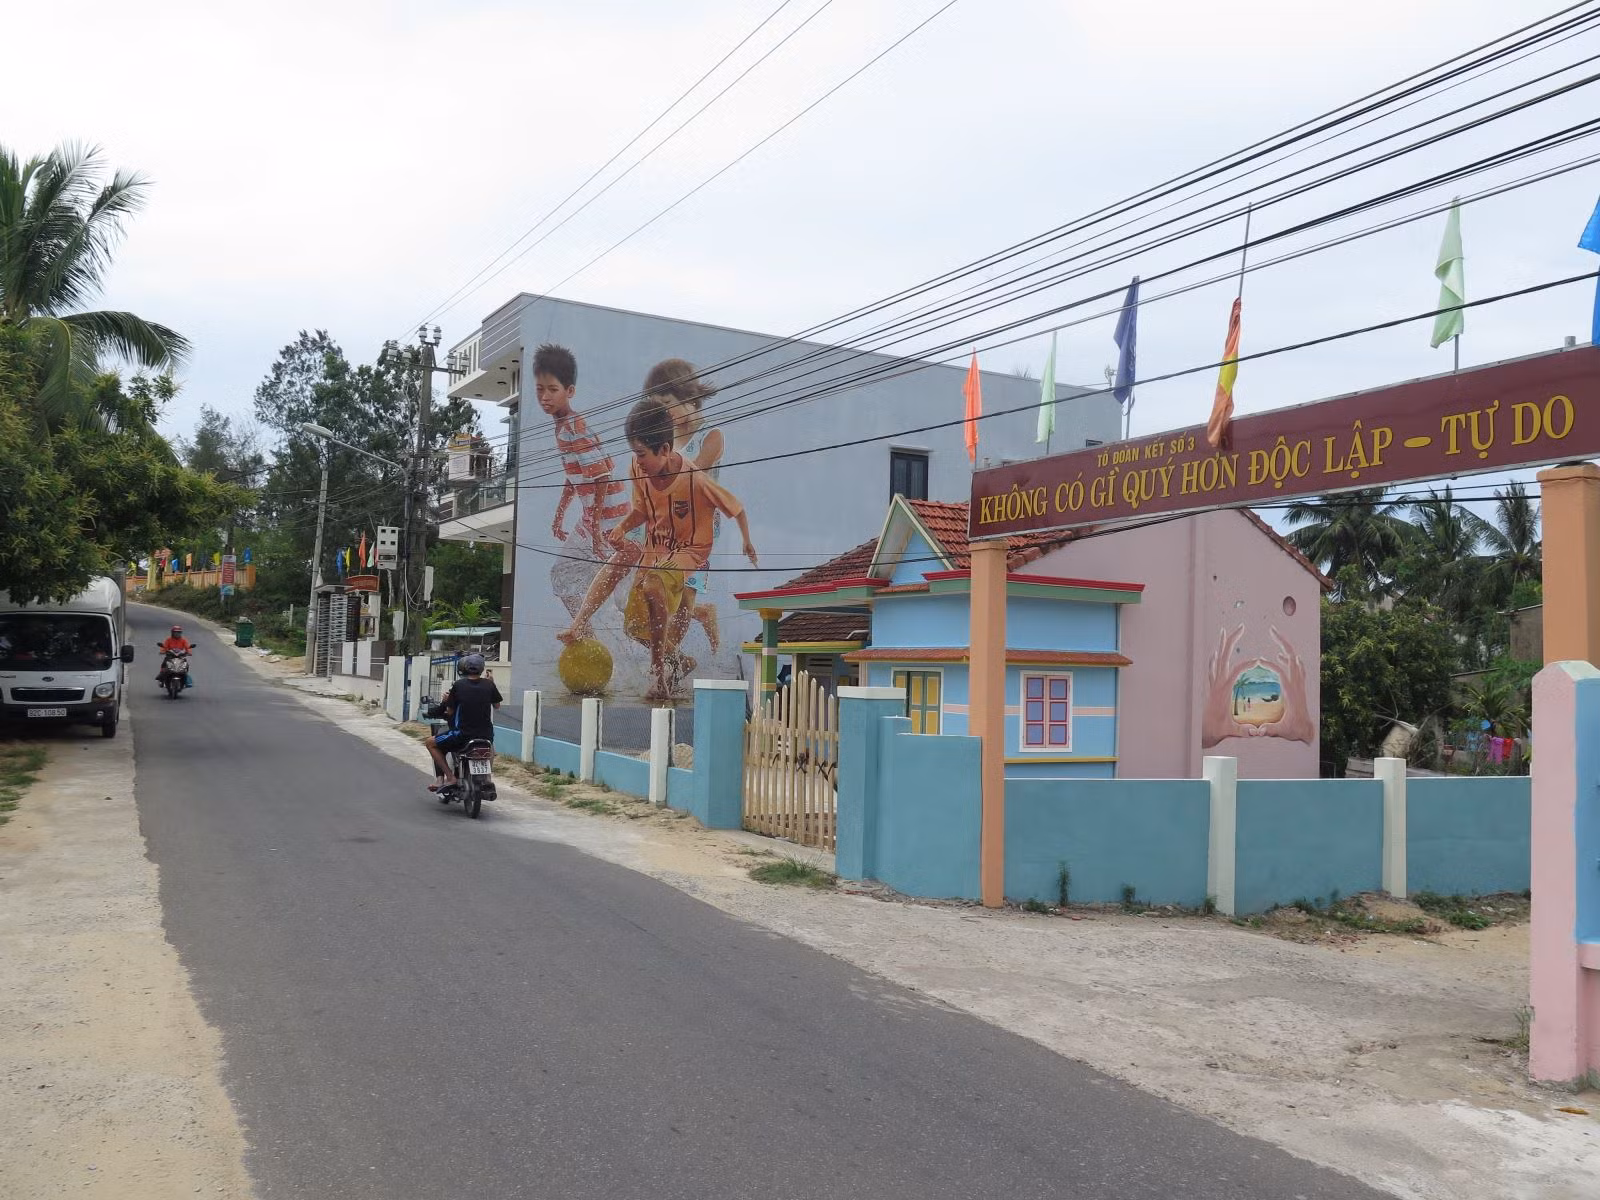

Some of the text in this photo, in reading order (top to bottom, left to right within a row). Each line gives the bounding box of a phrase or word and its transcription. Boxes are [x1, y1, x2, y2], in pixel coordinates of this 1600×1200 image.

[979, 483, 1048, 524] KHÔNG
[1055, 472, 1084, 513] CÓ
[1090, 468, 1120, 508] GÌ
[1123, 457, 1175, 509] QUÝ
[1180, 451, 1239, 495] HƠN
[1248, 436, 1311, 488] ĐỘC
[1322, 420, 1393, 479] LẬP
[1440, 399, 1499, 459] TỰ
[1511, 395, 1575, 445] DO
[1112, 445, 1140, 465] ĐOÀN
[1144, 437, 1165, 459] KẾT
[1170, 432, 1187, 454] SỐ
[1187, 436, 1195, 451] 3
